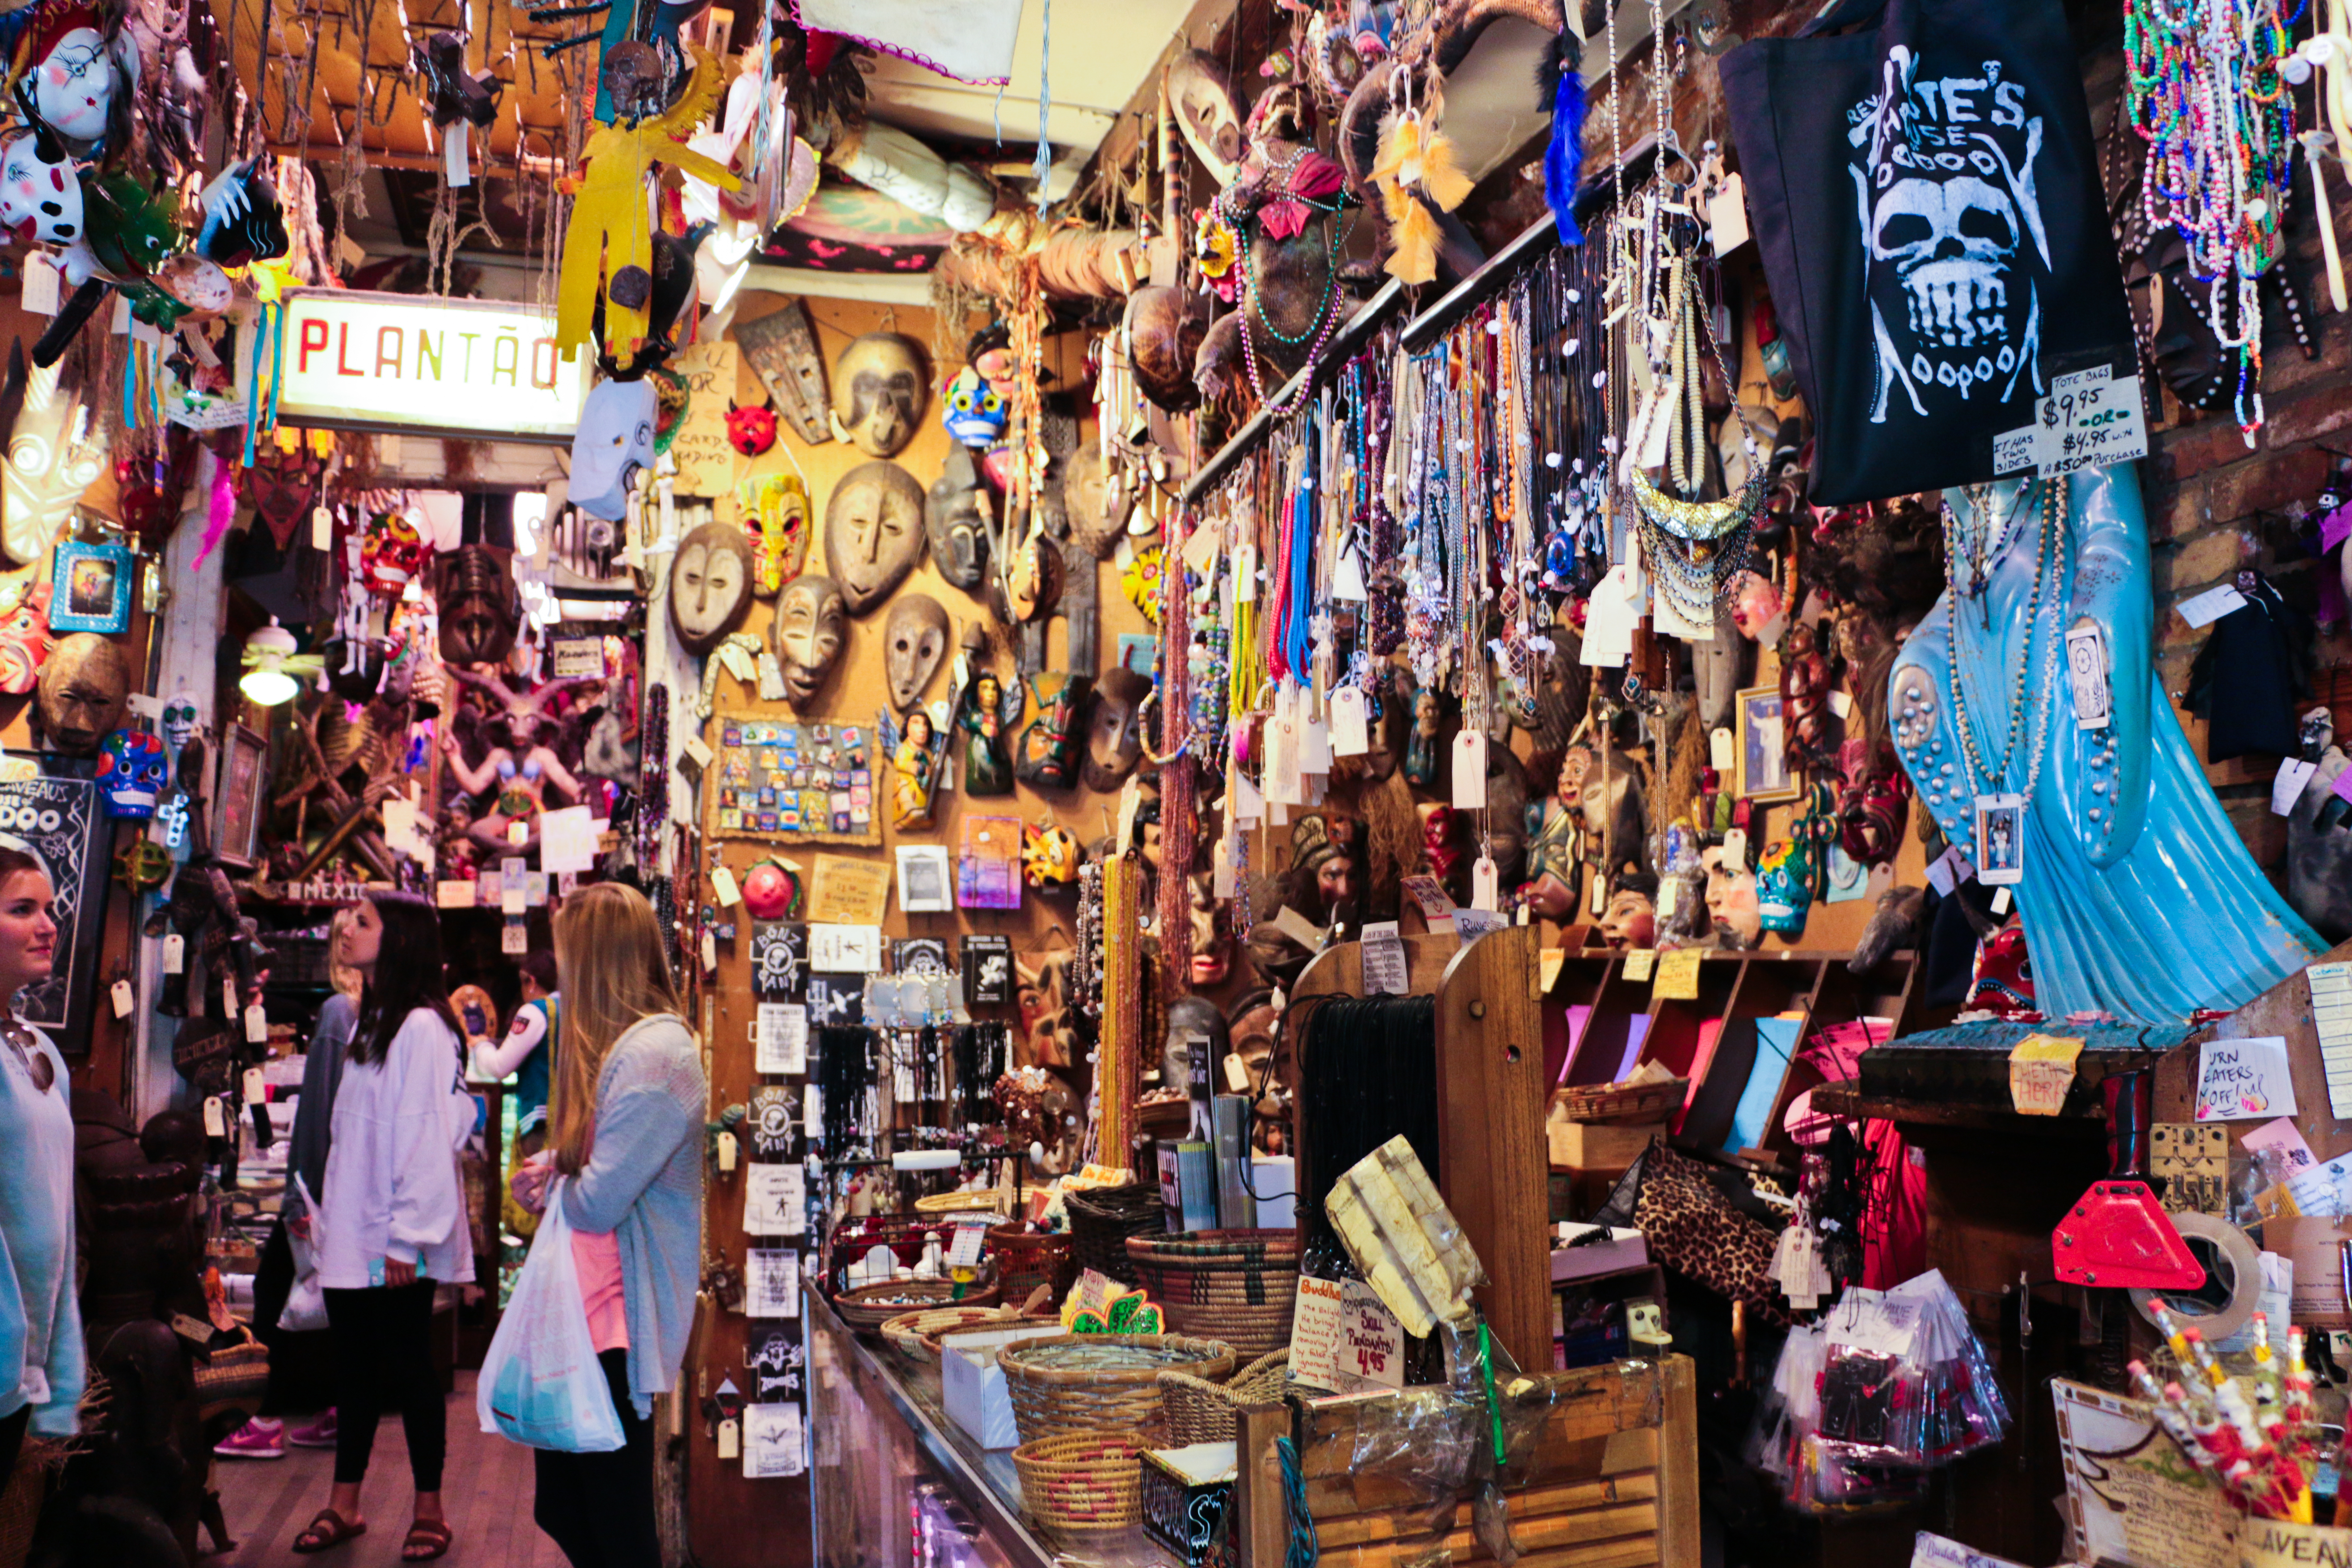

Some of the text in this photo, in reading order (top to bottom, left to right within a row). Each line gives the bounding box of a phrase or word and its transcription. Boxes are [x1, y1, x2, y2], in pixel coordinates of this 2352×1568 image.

[298, 318, 558, 390] PLANTÃO
[2054, 368, 2109, 389] TOTE BAGS
[2043, 388, 2104, 430] $9.95
[1994, 435, 2033, 454] IT HAS
[2063, 429, 2110, 455] $4.95
[2003, 448, 2026, 459] TWO
[1997, 456, 2031, 471] SIDES
[1302, 1314, 1310, 1323] He
[1299, 1323, 1330, 1337] balance
[1297, 1336, 1328, 1352] removing
[1357, 1348, 1386, 1376] 4.95
